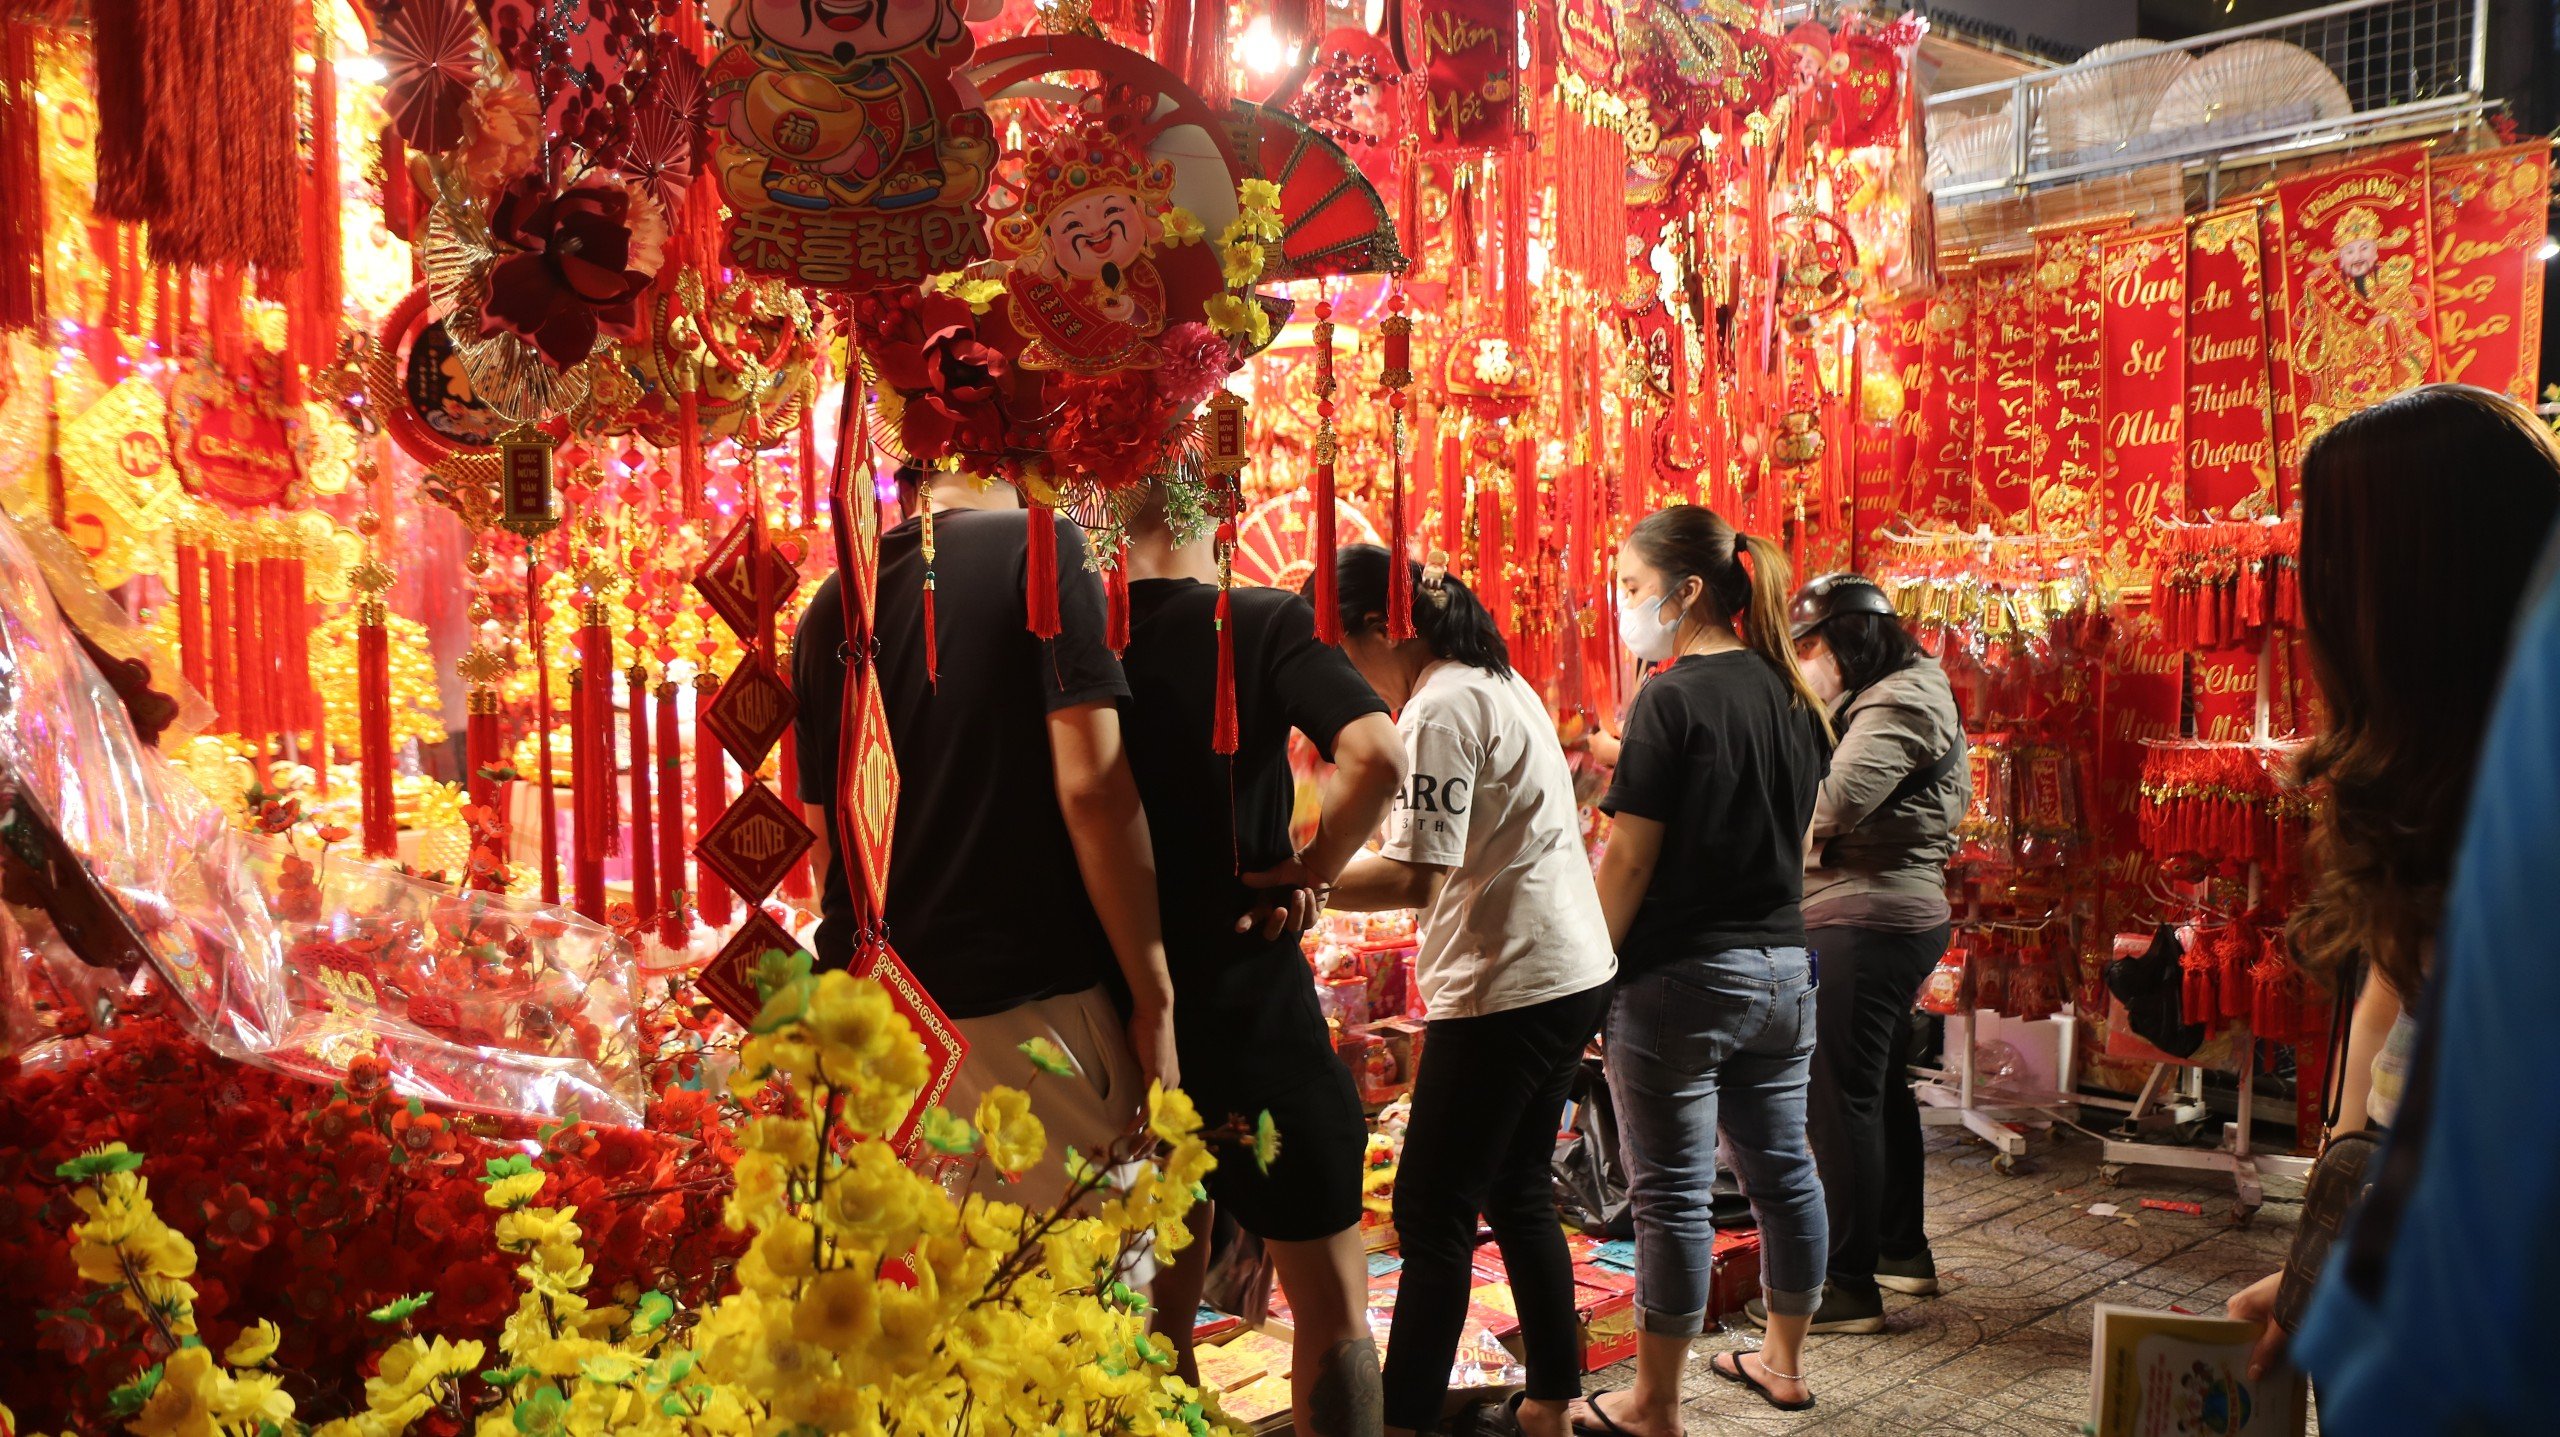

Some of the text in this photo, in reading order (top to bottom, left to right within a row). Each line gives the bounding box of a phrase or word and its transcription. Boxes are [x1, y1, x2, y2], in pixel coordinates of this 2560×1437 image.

[1424, 10, 1498, 64] Năm
[775, 114, 815, 152] 福
[1427, 90, 1484, 138] Mới
[732, 206, 987, 282] 恭喜發財
[2107, 270, 2181, 311] Vạn
[2191, 281, 2233, 314] An
[2122, 339, 2166, 380] Sự
[2188, 333, 2260, 365] Khang
[2188, 377, 2255, 418] Thịnh
[2107, 409, 2181, 448] Như
[2190, 437, 2266, 473] Vượng
[2125, 473, 2161, 525] Ý
[2115, 643, 2181, 675] Chúc
[2205, 663, 2257, 695] Chú
[735, 677, 779, 735] KHANG
[730, 813, 787, 874] THỊNH
